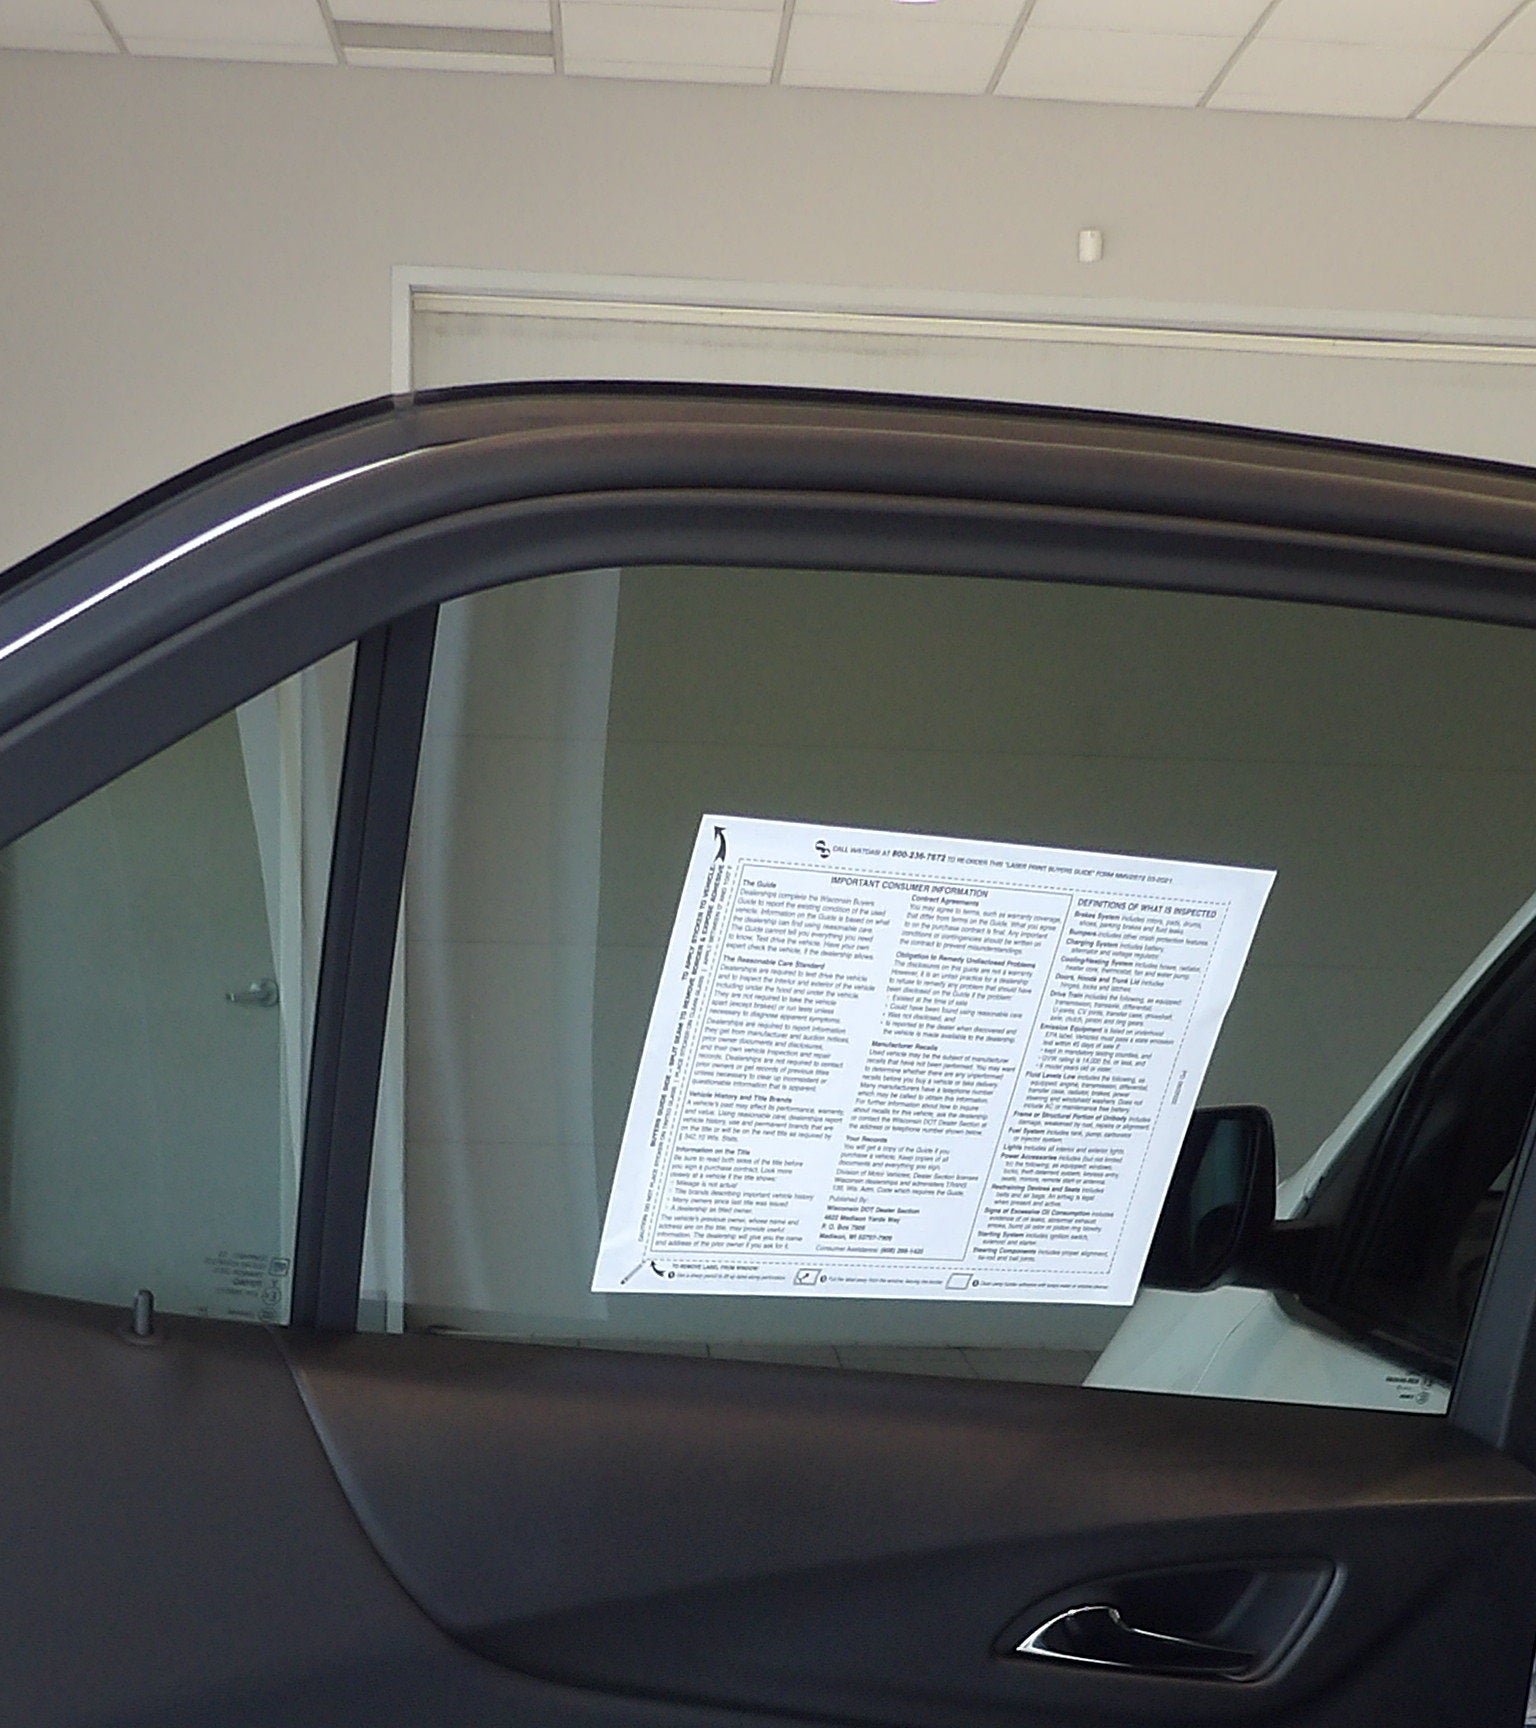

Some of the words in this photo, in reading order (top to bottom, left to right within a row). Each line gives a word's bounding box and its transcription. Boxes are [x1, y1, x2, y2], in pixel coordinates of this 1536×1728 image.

[743, 879, 755, 887] The
[756, 880, 777, 889] Guide
[830, 877, 880, 888] IMPORTANT
[881, 881, 930, 892] CONSUMER
[931, 886, 989, 898] INFORMATION
[1077, 899, 1126, 910] DEFINITIONS
[1127, 903, 1138, 911] OF
[1140, 904, 1163, 913] WHAT
[1164, 906, 1172, 914] IS
[1173, 907, 1217, 918] INSPECTED
